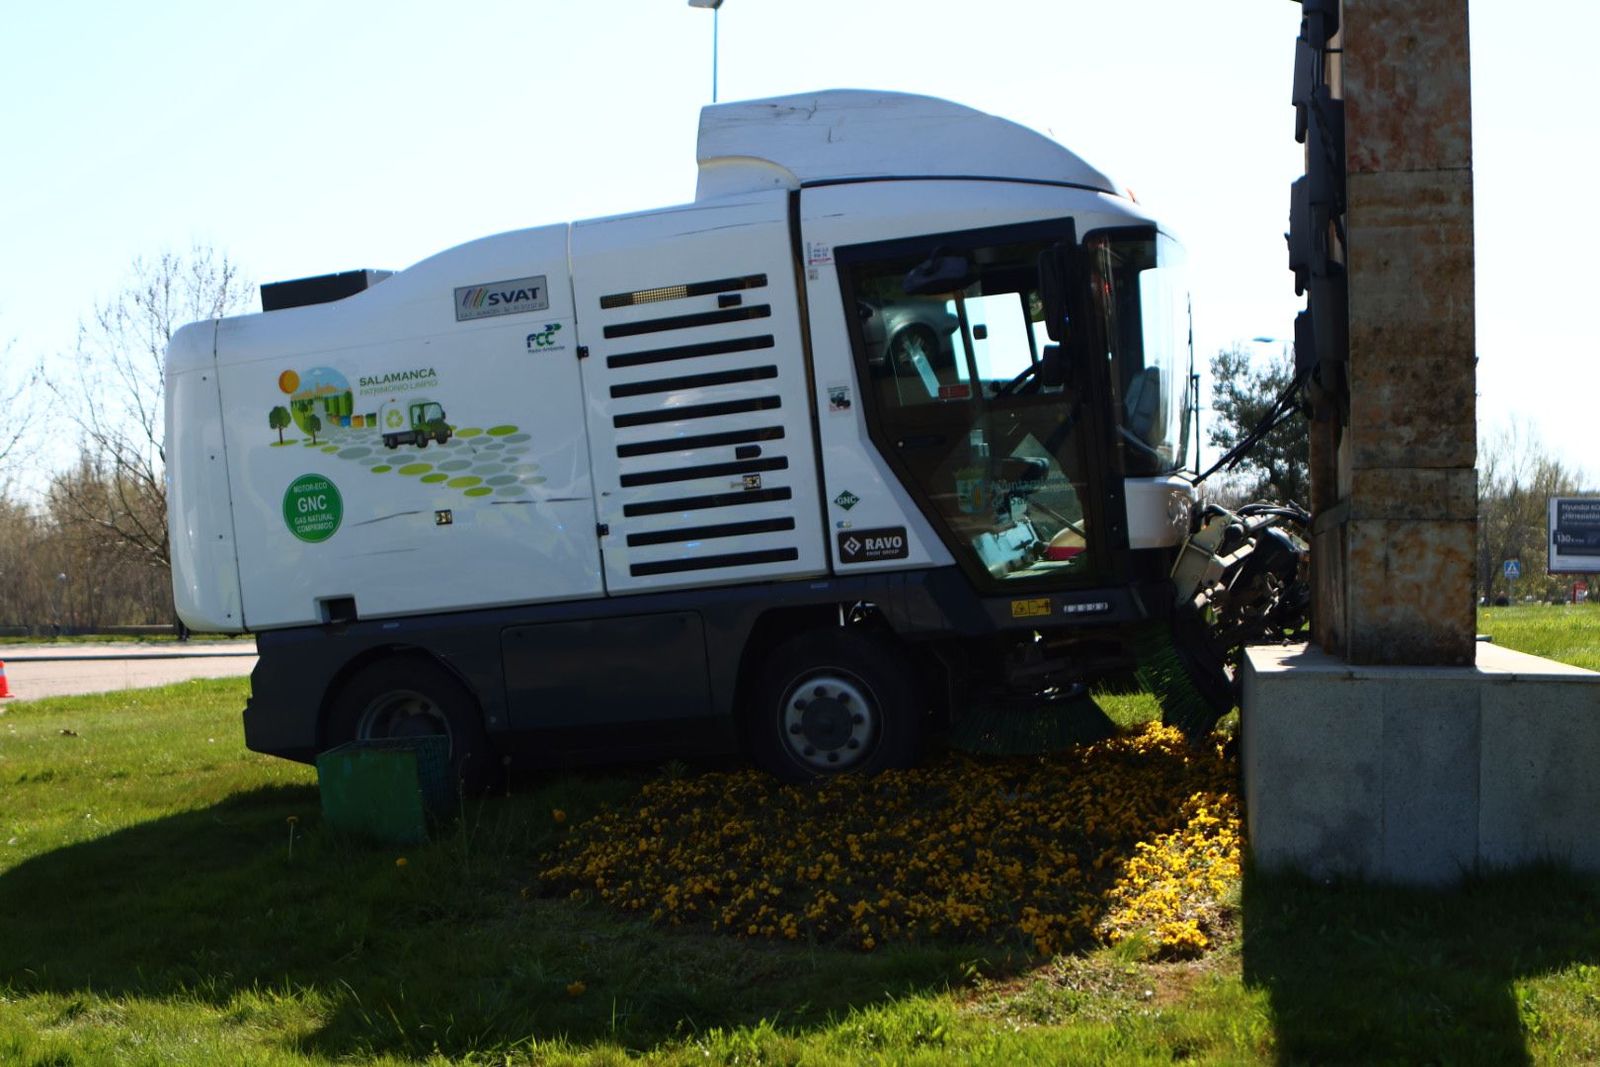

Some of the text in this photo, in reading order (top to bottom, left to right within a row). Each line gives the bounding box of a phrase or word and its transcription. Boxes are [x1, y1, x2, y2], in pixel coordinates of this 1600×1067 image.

[488, 287, 540, 306] SVAT
[359, 367, 437, 386] SALAMANCA
[297, 494, 327, 513] GNC
[865, 535, 903, 550] RAVO
